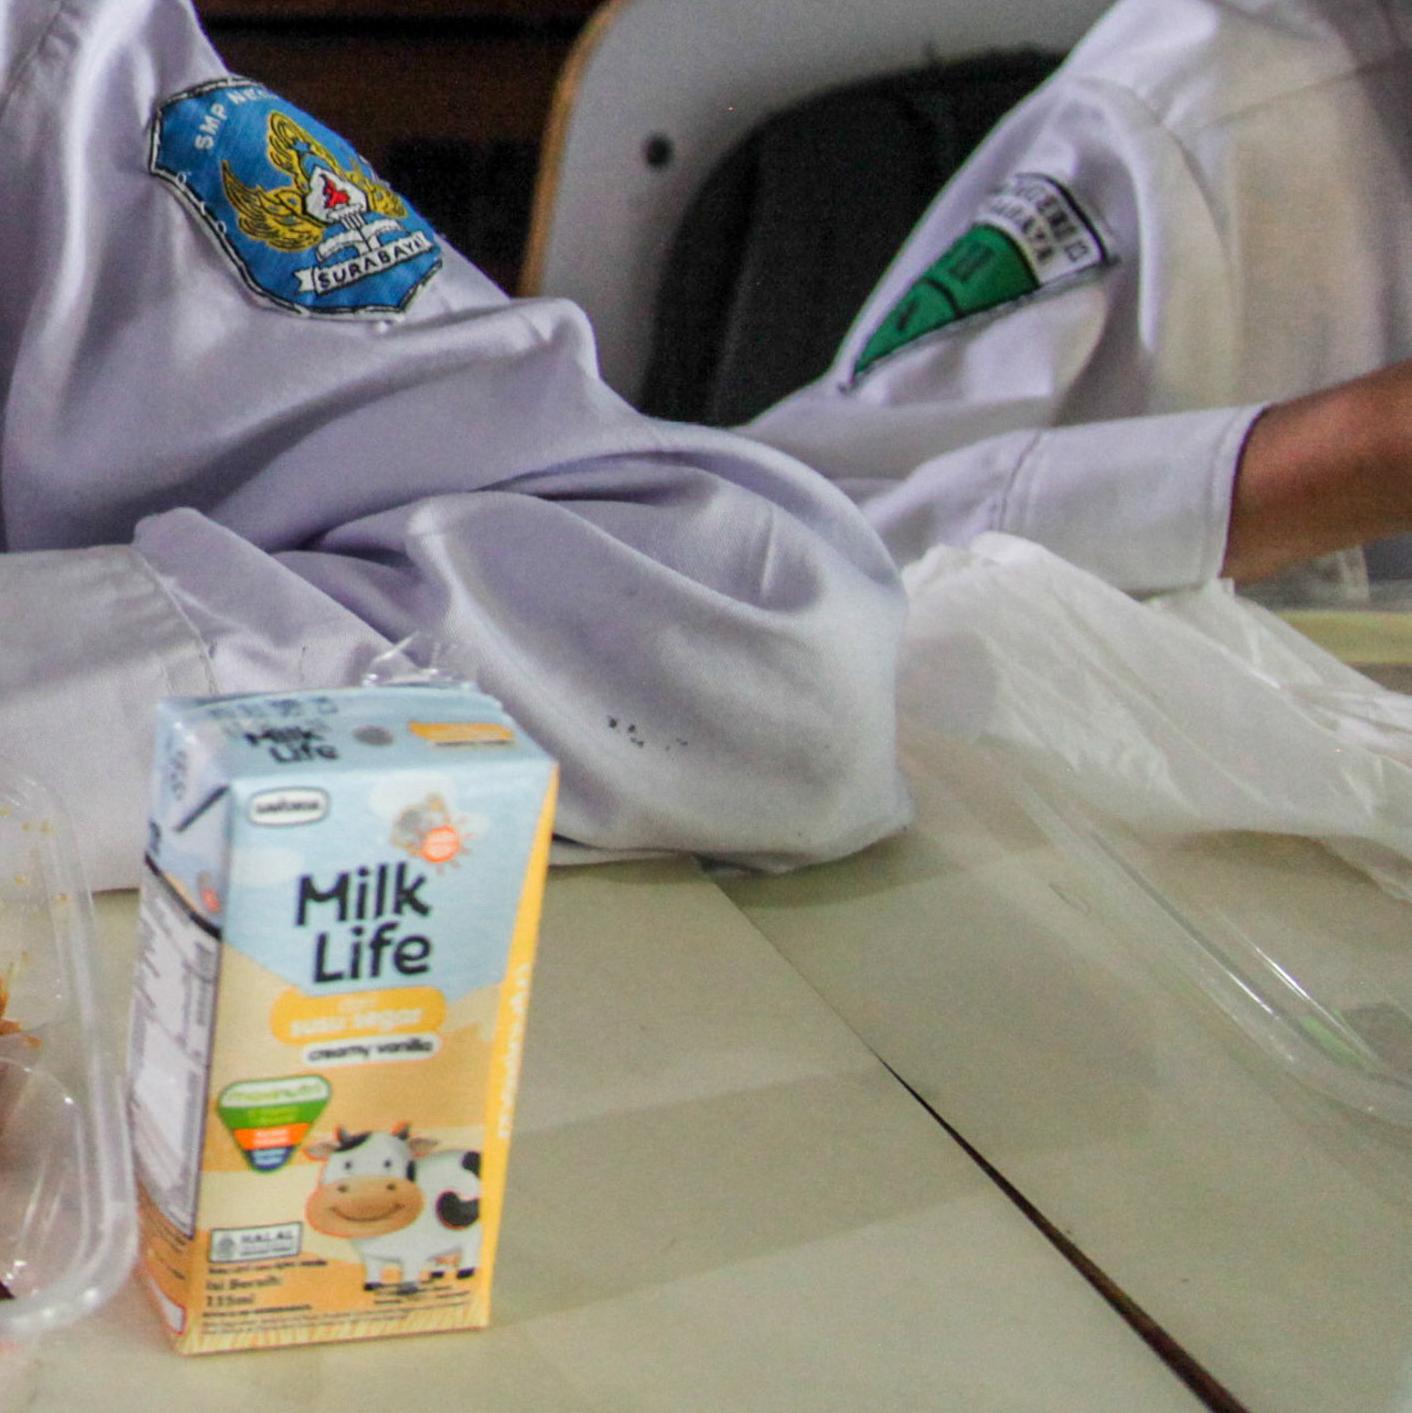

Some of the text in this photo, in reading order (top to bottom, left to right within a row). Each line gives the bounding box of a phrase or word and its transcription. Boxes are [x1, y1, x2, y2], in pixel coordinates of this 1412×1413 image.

[195, 103, 228, 149] SMP
[295, 861, 432, 927] Milk
[313, 920, 432, 984] Life
